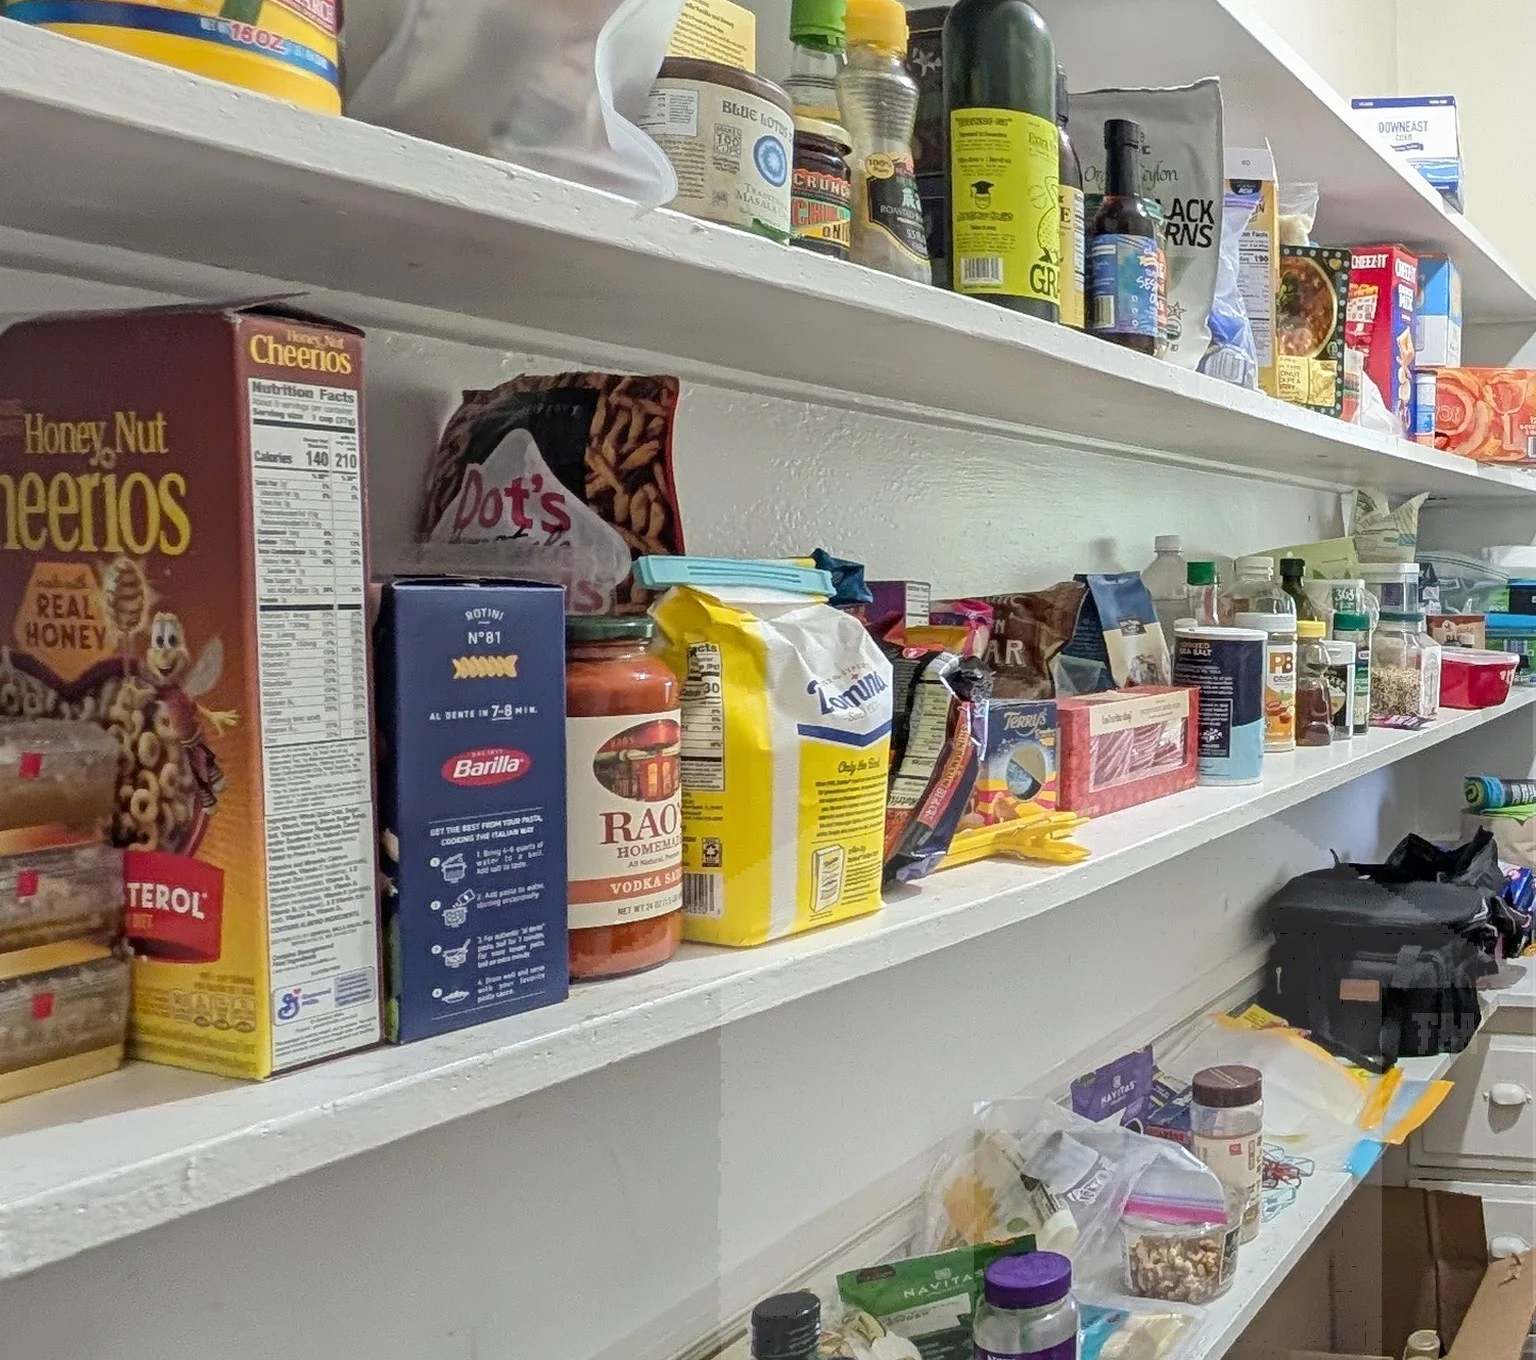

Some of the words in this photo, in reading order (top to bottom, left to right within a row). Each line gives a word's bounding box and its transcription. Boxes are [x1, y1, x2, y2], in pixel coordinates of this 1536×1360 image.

[722, 99, 758, 123] BLUE
[1378, 120, 1429, 134] DOWNEAST
[250, 333, 353, 375] Cheerios
[251, 380, 315, 400] Nutrition
[319, 388, 356, 404] Facts
[24, 411, 107, 459] Honey
[114, 410, 169, 455] Nut
[253, 449, 294, 466] Calories
[305, 450, 330, 467] 140
[334, 452, 358, 469] 210
[453, 468, 573, 535] Dot's
[36, 592, 96, 621] REAL
[26, 621, 108, 652] HONEY
[428, 710, 443, 722] AL
[445, 708, 476, 720] DENTE
[477, 707, 489, 718] IN
[490, 703, 514, 720] 7-8
[452, 753, 522, 779] Barilla
[609, 875, 662, 896] VODKA
